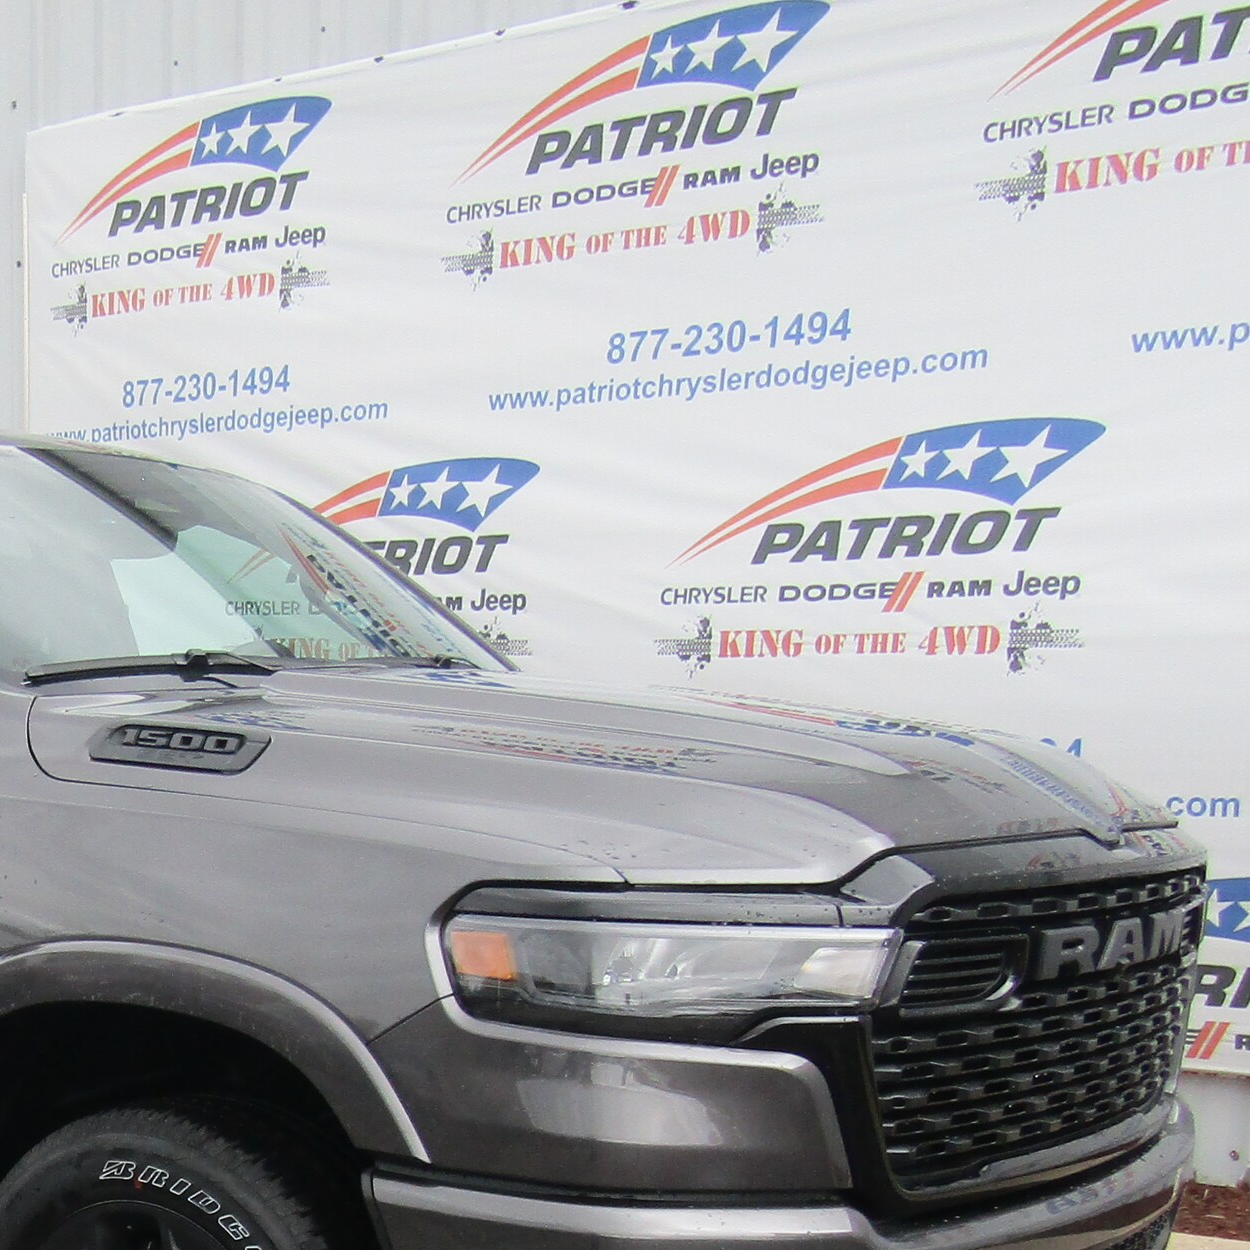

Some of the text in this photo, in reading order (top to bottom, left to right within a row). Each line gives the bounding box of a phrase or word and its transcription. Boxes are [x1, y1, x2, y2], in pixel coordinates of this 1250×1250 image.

[1092, 6, 1250, 83] PAT
[525, 87, 798, 176] PATRIOT
[983, 104, 1114, 143] CHRYSLER
[446, 150, 820, 224] CHRYSLER DODGE RAM Jeep
[1054, 147, 1161, 194] KING
[1174, 145, 1215, 173] OF
[108, 170, 310, 237] PATRIOT
[51, 225, 326, 278] CHRYSLER DODGE RAM Jeep
[498, 207, 751, 269] KING OF THE 4WD
[91, 272, 276, 319] KING OF THE 4WD
[606, 307, 851, 365] 877-230-1494
[122, 364, 290, 408] 877-230-1494
[488, 345, 989, 412] www.patriotchryslerdodgejeep.com
[750, 507, 1062, 565] PATRIOT
[225, 600, 300, 616] CHRYSLER
[470, 588, 527, 615] Jeep
[660, 570, 1082, 606] CHRYSLER DODGE RAM Jeep
[717, 625, 1001, 658] KING OF THE 4WD
[123, 728, 241, 753] 1500
[1036, 909, 1185, 980] RAM
